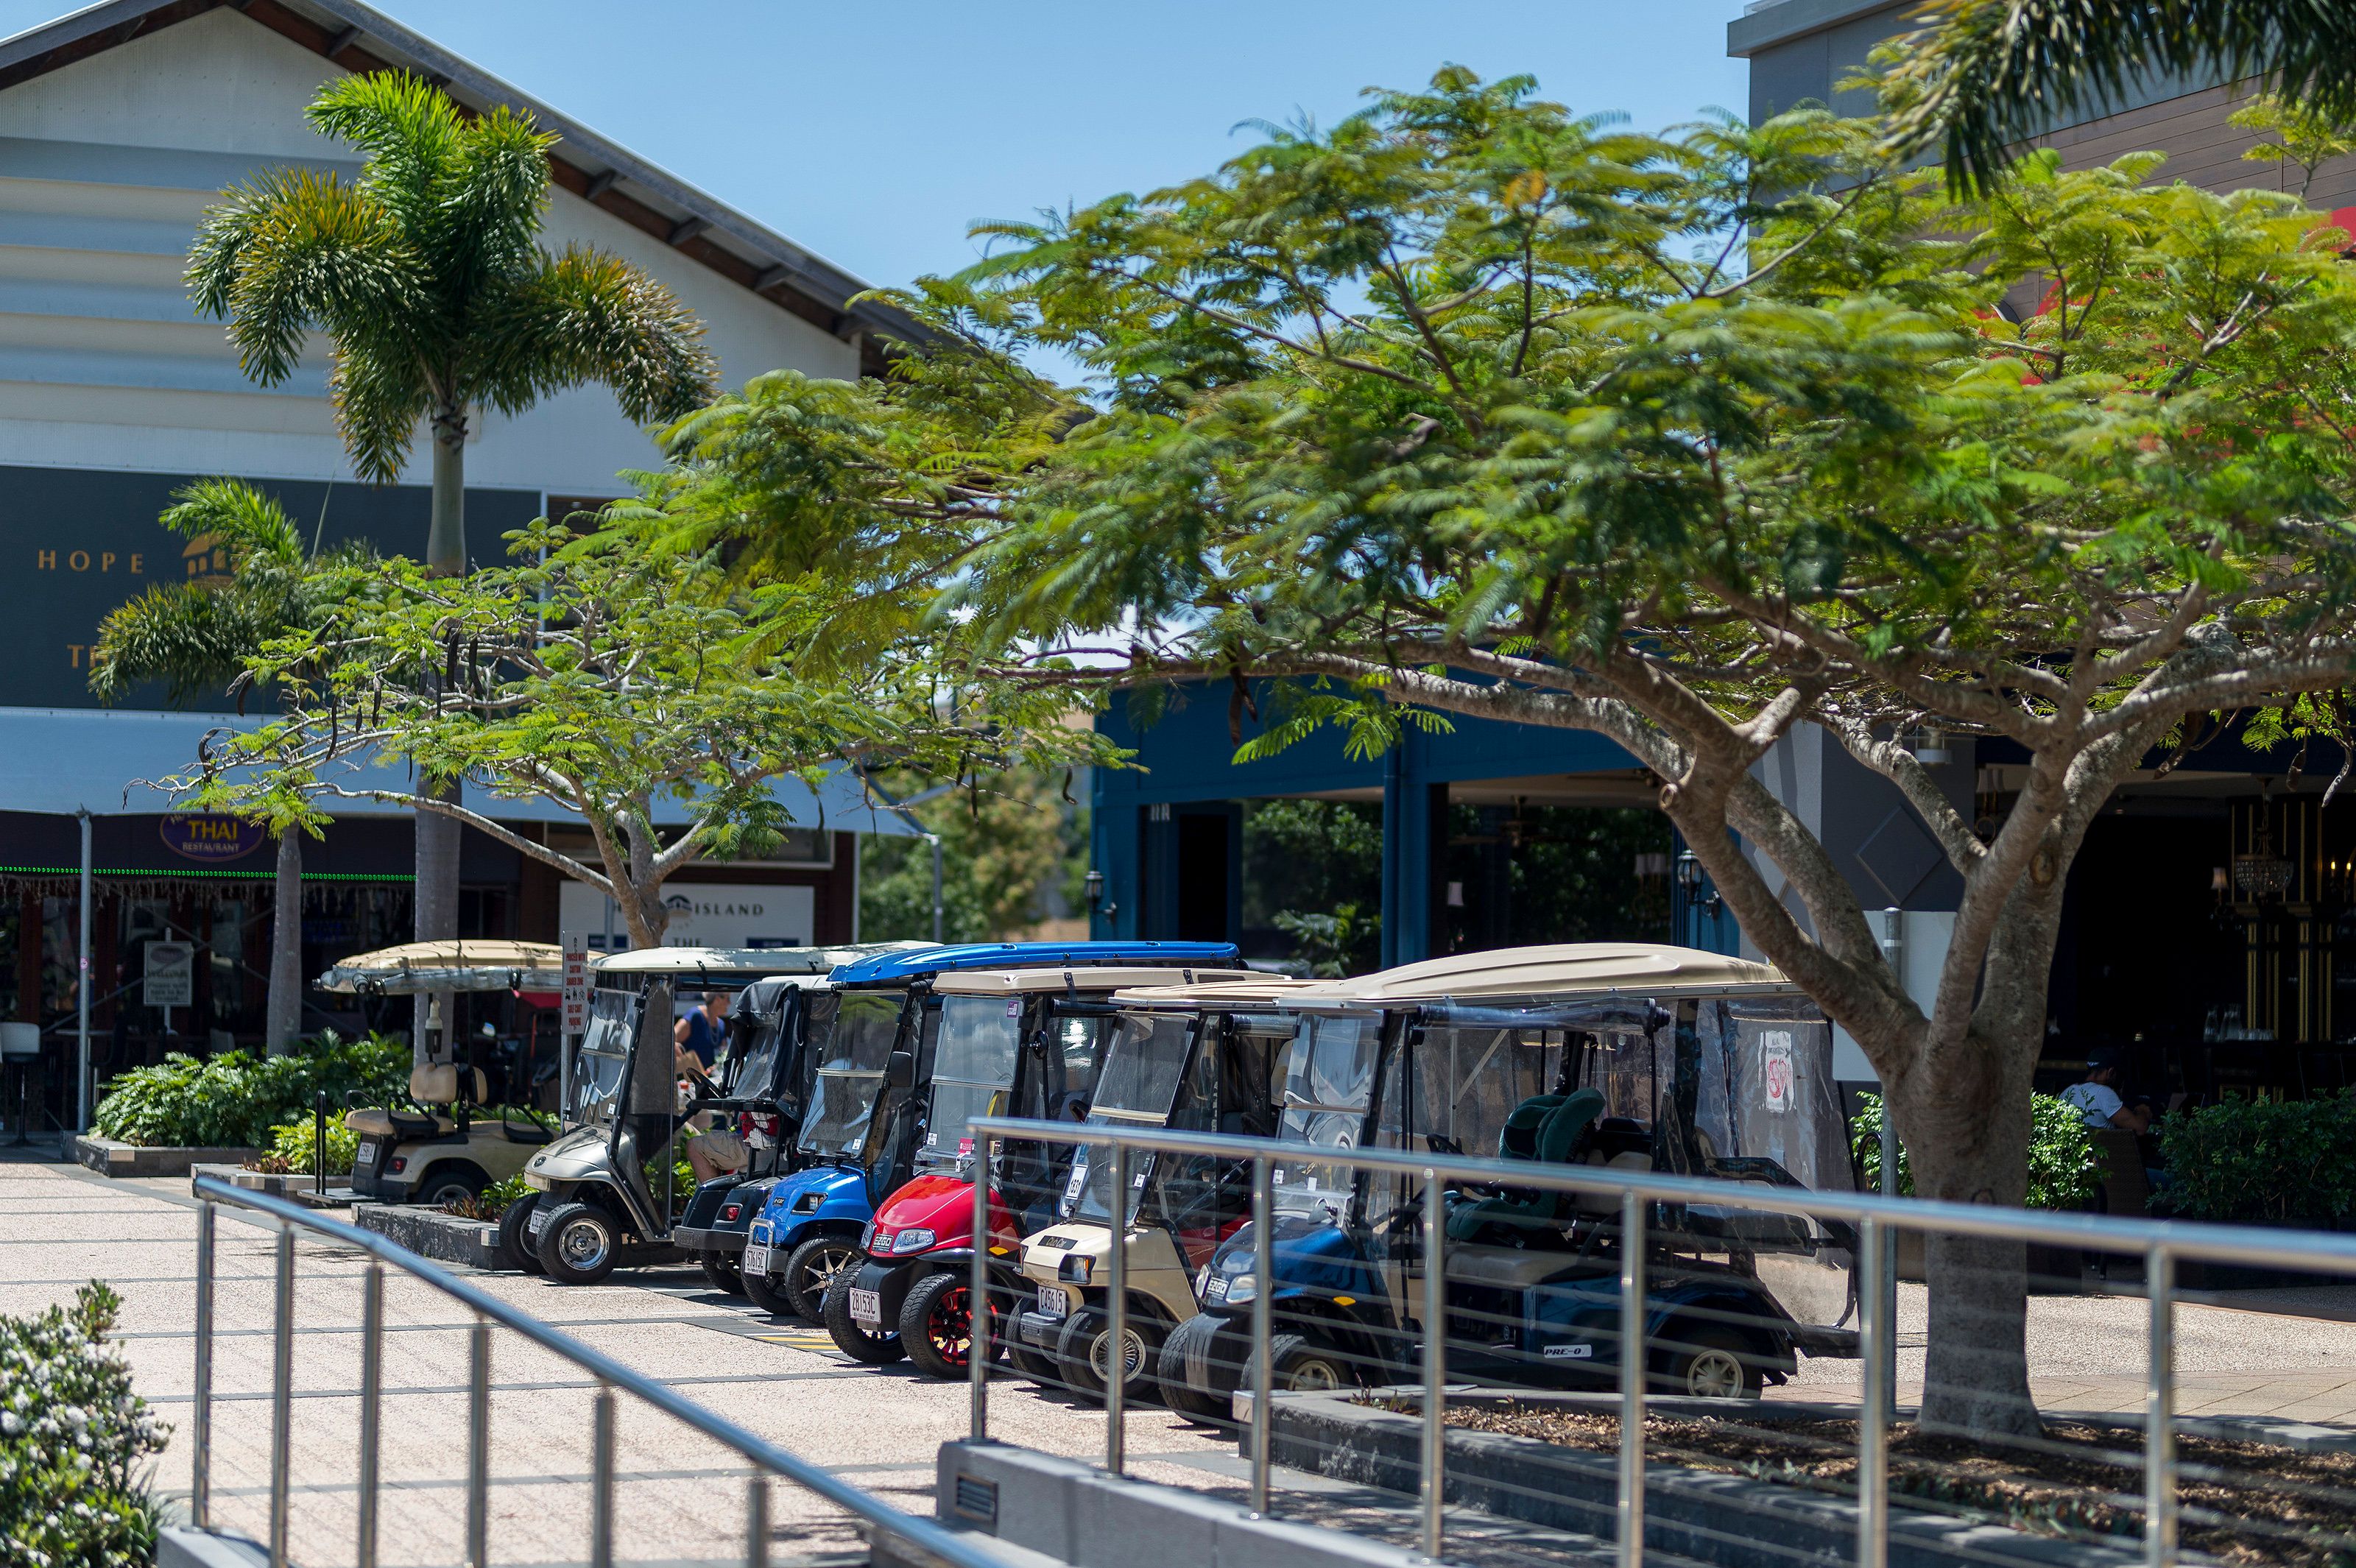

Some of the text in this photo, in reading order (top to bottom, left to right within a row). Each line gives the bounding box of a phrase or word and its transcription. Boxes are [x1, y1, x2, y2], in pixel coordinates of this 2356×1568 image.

[38, 549, 144, 573] HOPE
[188, 820, 238, 840] THAI
[183, 842, 240, 852] RESTAURANT
[695, 903, 764, 916] ISLAND
[852, 1292, 875, 1315] 28153C
[1040, 1288, 1062, 1313] C45615
